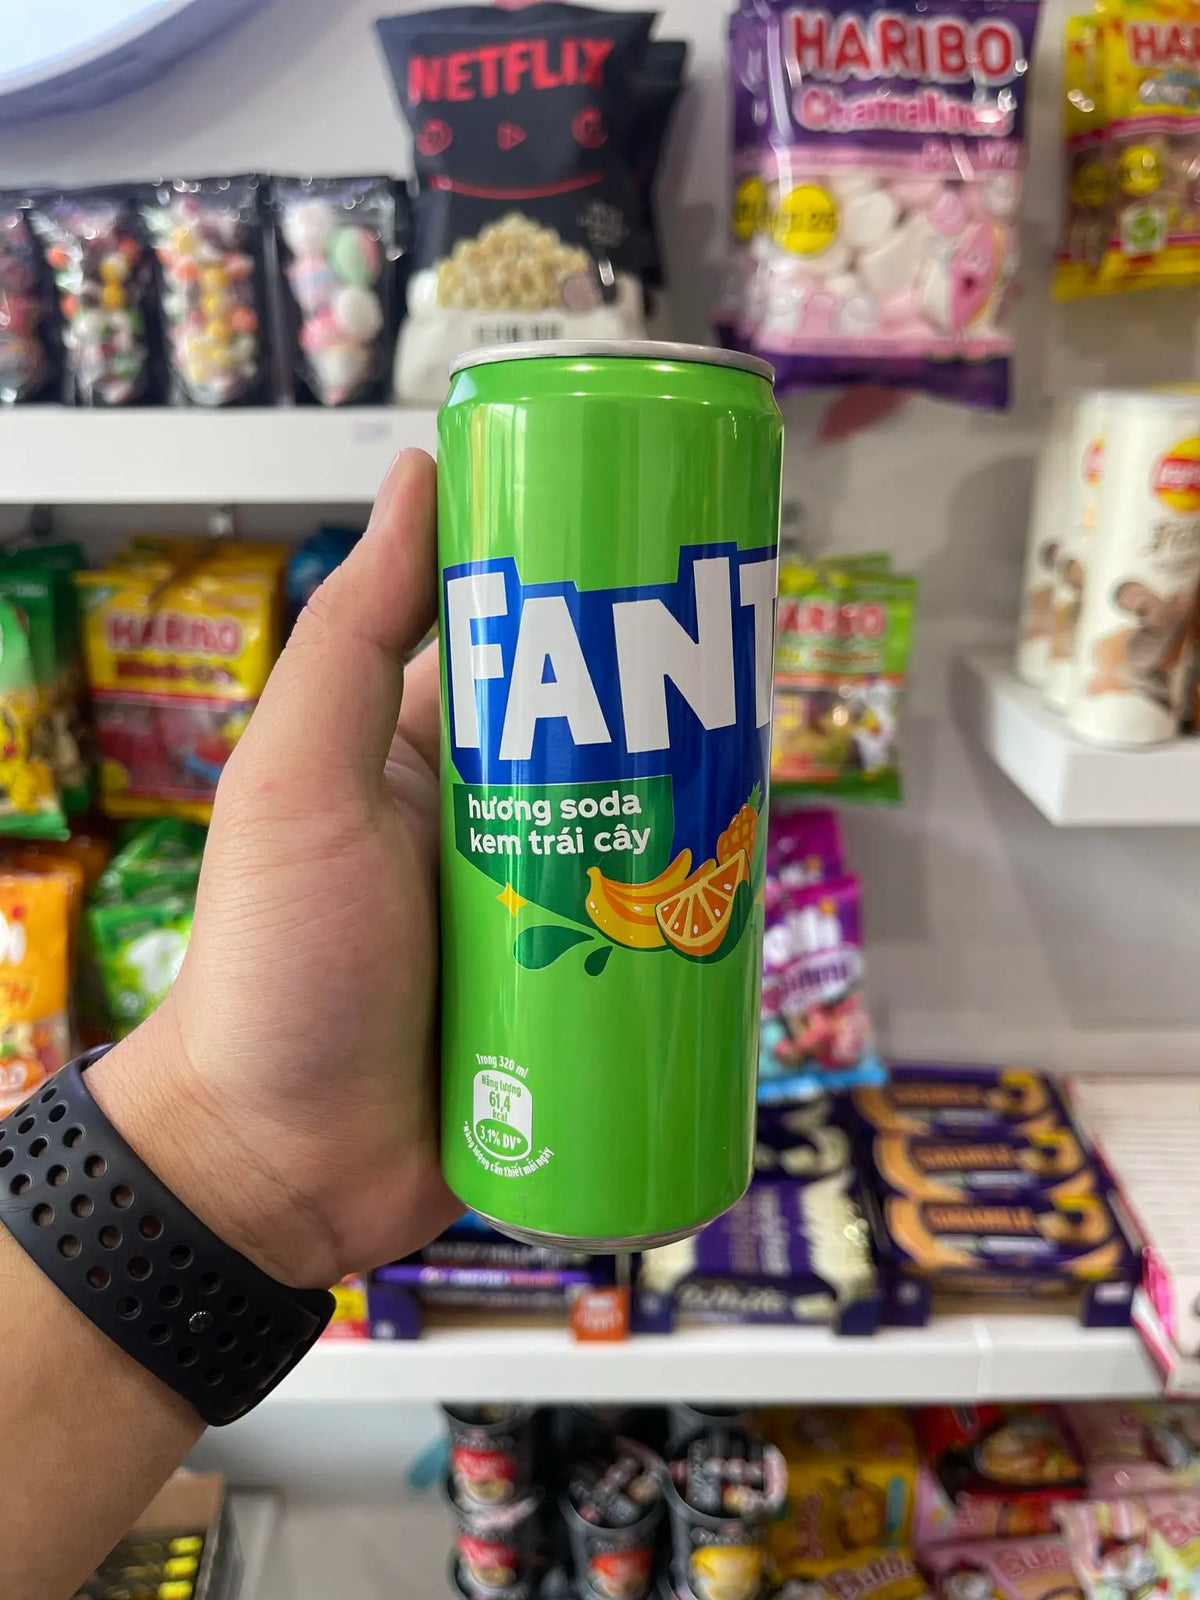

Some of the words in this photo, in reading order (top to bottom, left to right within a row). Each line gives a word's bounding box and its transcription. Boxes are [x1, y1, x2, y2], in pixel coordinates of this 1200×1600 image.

[788, 13, 1015, 79] HARIBO
[406, 38, 614, 104] NETFLIX
[778, 601, 885, 640] ARIBO
[468, 793, 551, 826] hương
[560, 790, 642, 819] soda
[470, 827, 522, 855] kem
[528, 826, 584, 855] trái
[594, 823, 651, 855] cây
[475, 1053, 498, 1068] Trong
[499, 1055, 515, 1071] 320
[515, 1065, 529, 1079] ml
[489, 1091, 511, 1112] 61,4
[492, 1109, 508, 1123] kcal
[480, 1125, 501, 1146] 3,1%
